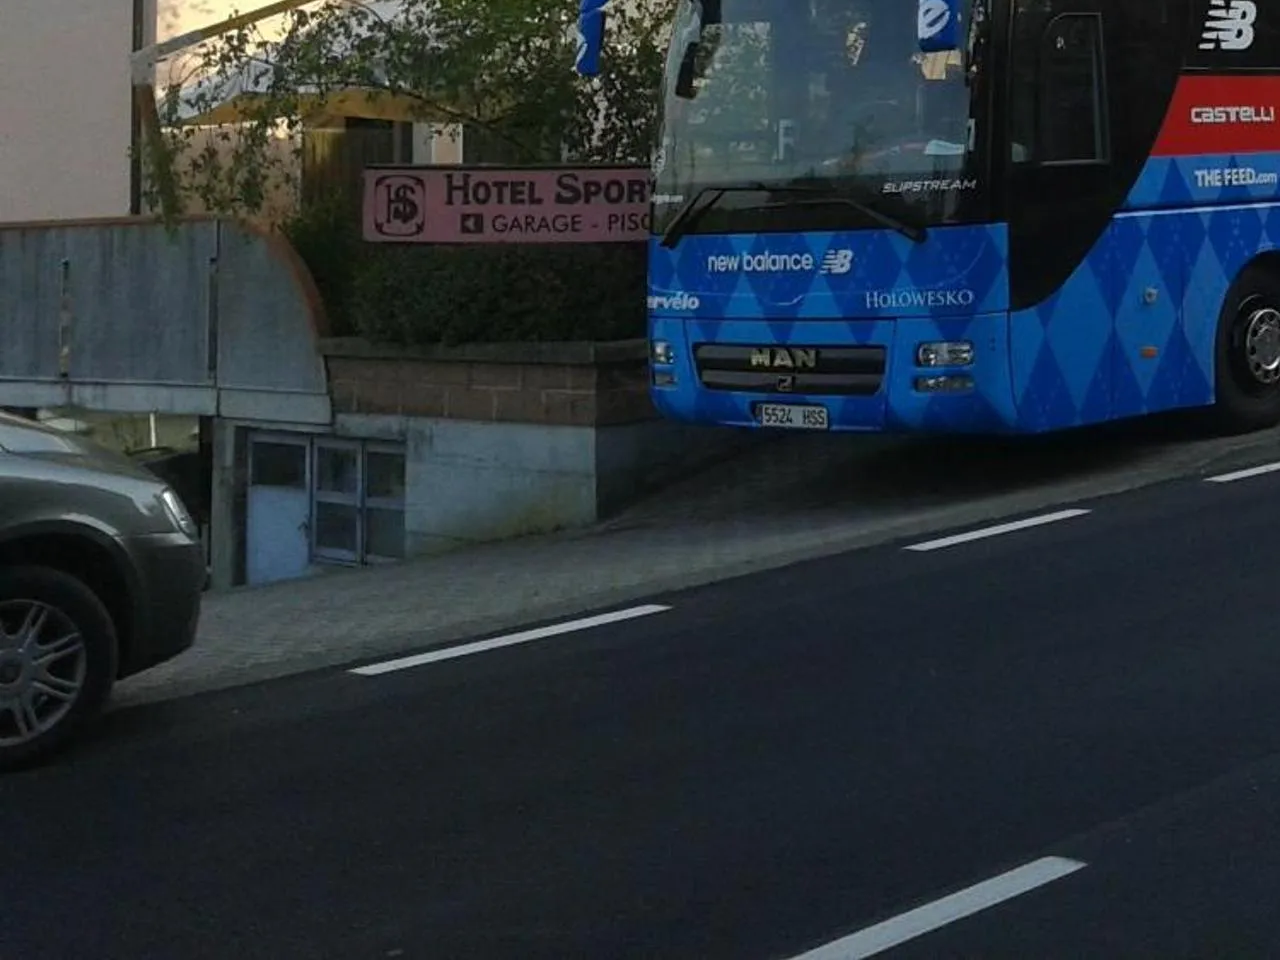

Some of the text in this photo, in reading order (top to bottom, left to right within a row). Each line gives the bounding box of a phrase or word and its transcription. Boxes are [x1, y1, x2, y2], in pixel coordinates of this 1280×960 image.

[882, 179, 977, 193] SLIPSTREAM
[1194, 169, 1221, 187] THE
[445, 172, 651, 206] HOTEL SPOR
[492, 214, 581, 233] GARAGE
[708, 254, 740, 272] new
[743, 250, 814, 272] balance
[866, 290, 974, 309] HOLOWESKO
[751, 348, 818, 368] MAN
[764, 406, 793, 424] 5524
